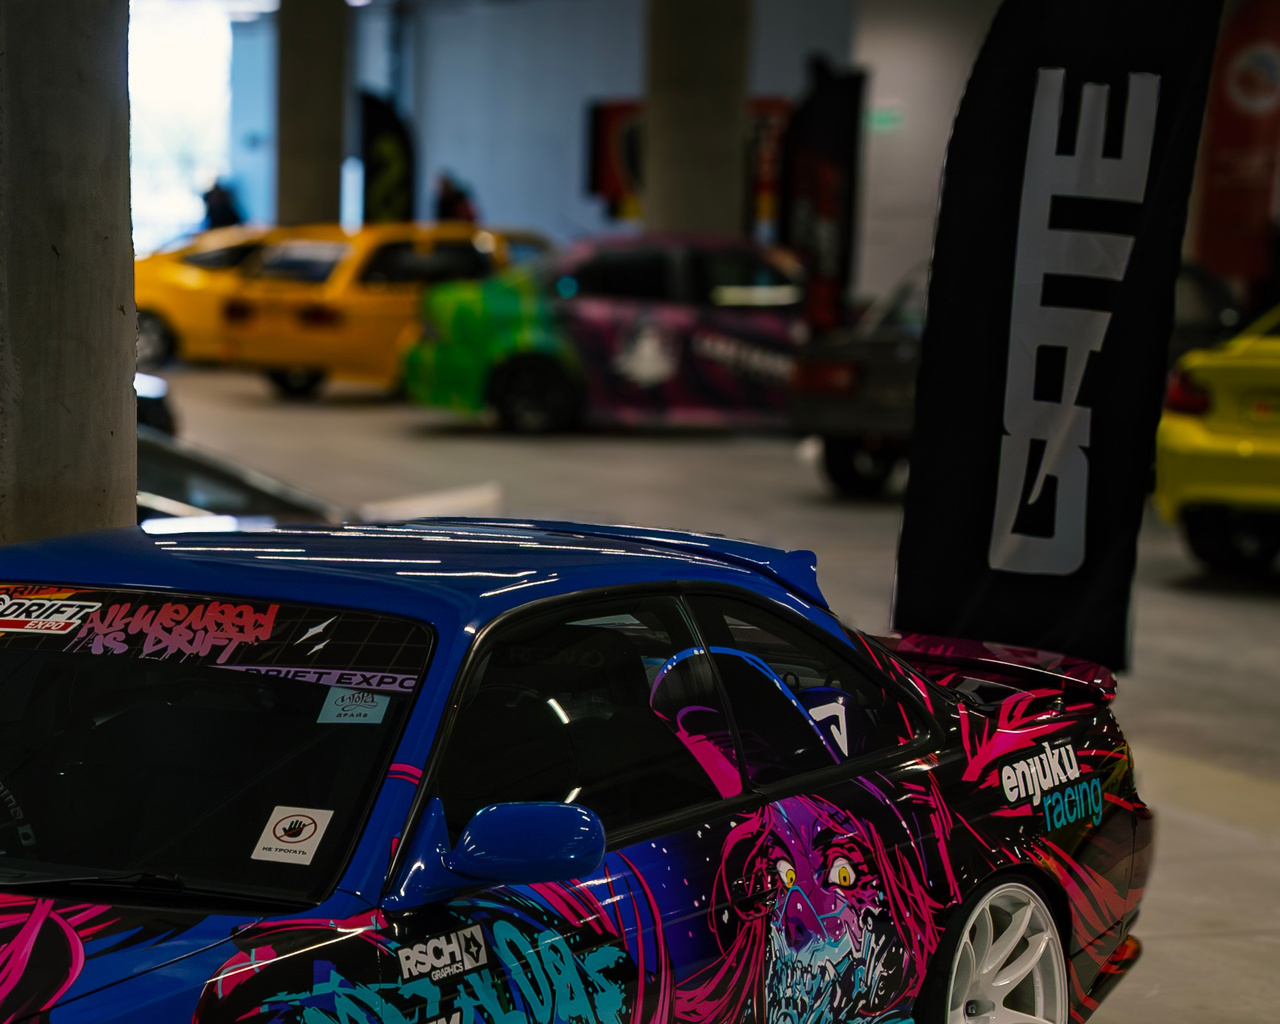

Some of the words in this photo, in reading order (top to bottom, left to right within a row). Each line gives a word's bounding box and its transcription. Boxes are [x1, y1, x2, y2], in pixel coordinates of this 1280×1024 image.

[24, 620, 66, 630] EXPO
[142, 625, 246, 664] DRIFT
[1001, 741, 1082, 806] enjuku
[1042, 777, 1103, 832] racing
[274, 848, 308, 856] ТРОГАТЬ
[397, 931, 461, 980] RSCH
[430, 962, 464, 981] GRAPHICS
